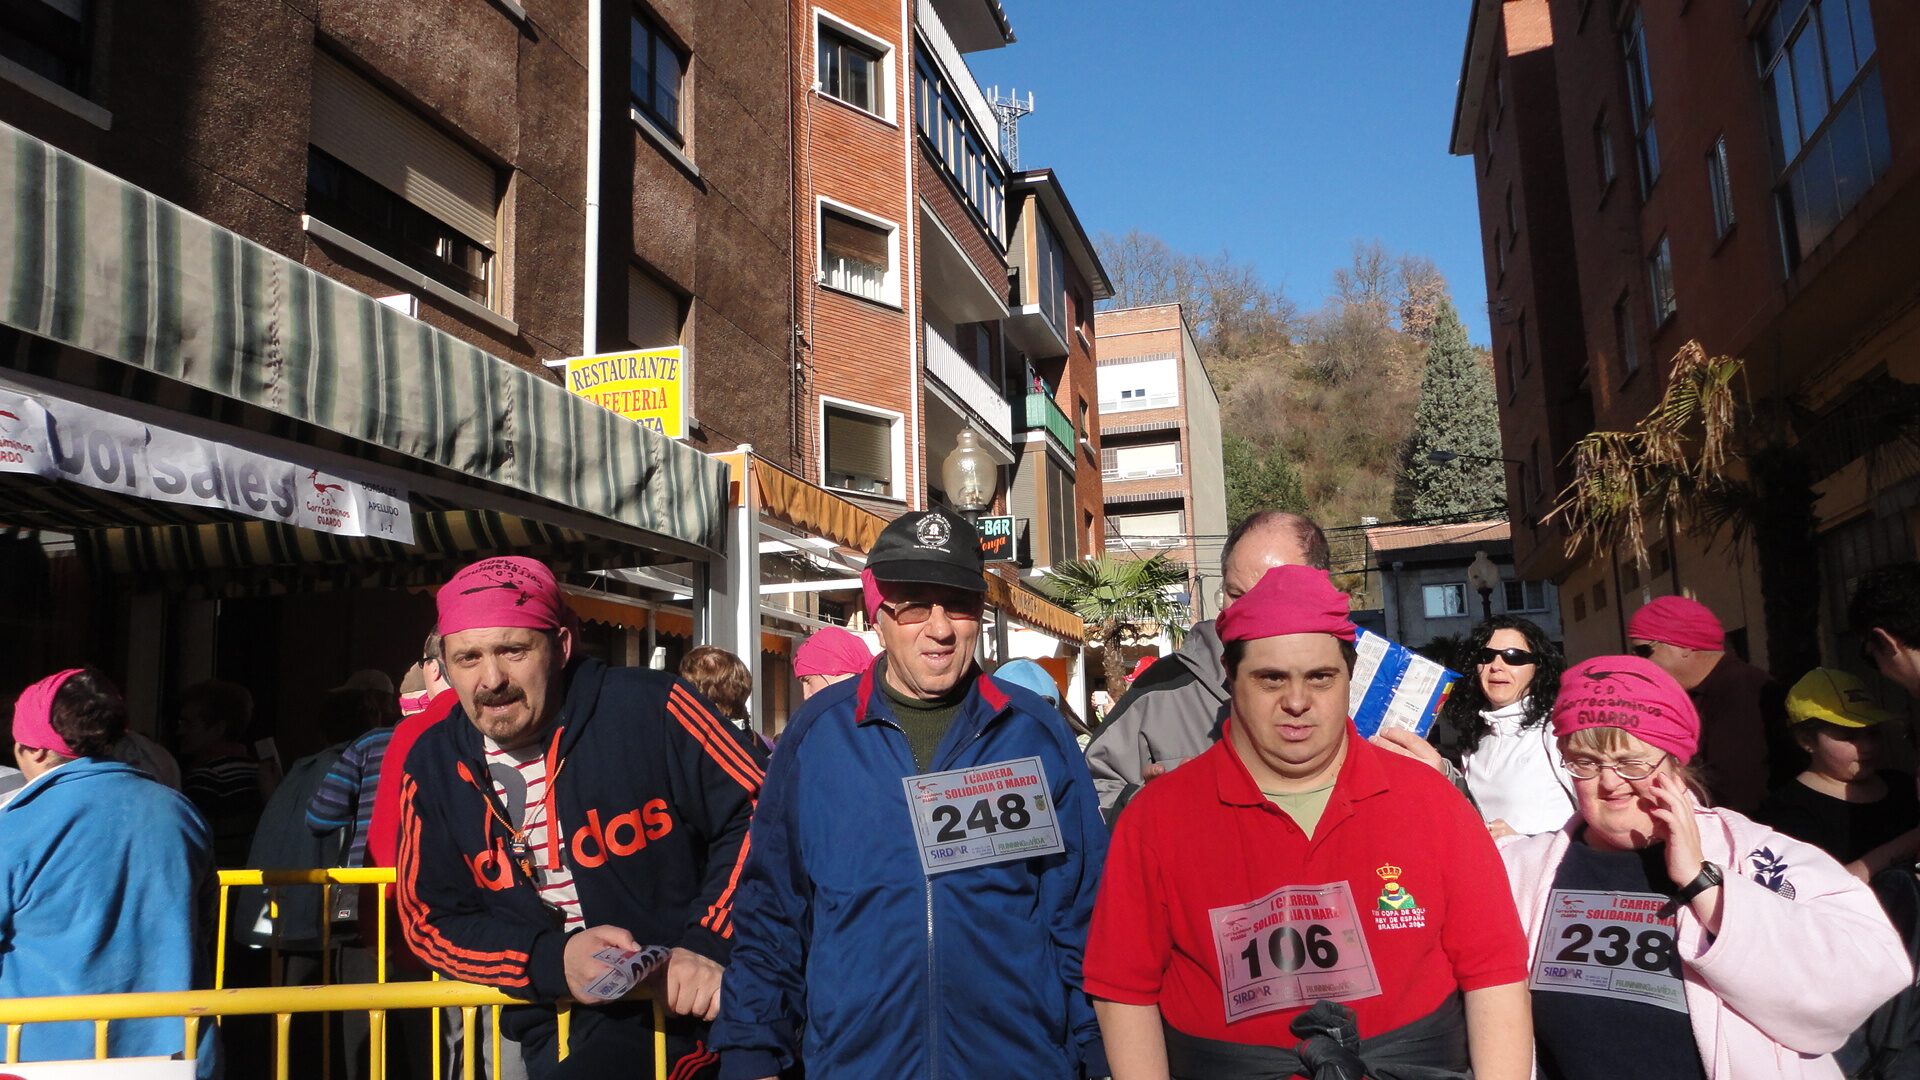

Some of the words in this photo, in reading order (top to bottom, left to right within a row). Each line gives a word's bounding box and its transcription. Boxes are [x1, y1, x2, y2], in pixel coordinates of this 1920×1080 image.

[571, 356, 679, 392] RESTAURANTE
[368, 501, 399, 517] APELLIDO
[1578, 710, 1640, 728] GUARDO
[969, 767, 1013, 784] CARRERA
[944, 782, 996, 800] SOLIDARIA
[997, 780, 1003, 790] 8
[1005, 774, 1038, 789] MARZO
[932, 793, 1031, 843] 248
[1276, 894, 1319, 909] CRRERA
[1620, 898, 1666, 912] CARRER
[1253, 908, 1303, 933] SOLIDAIA
[1304, 908, 1311, 920] 8
[1586, 909, 1643, 923] SOLIDARIA
[1646, 913, 1654, 924] 8
[1240, 924, 1339, 980] 106
[1556, 923, 1673, 972] 238
